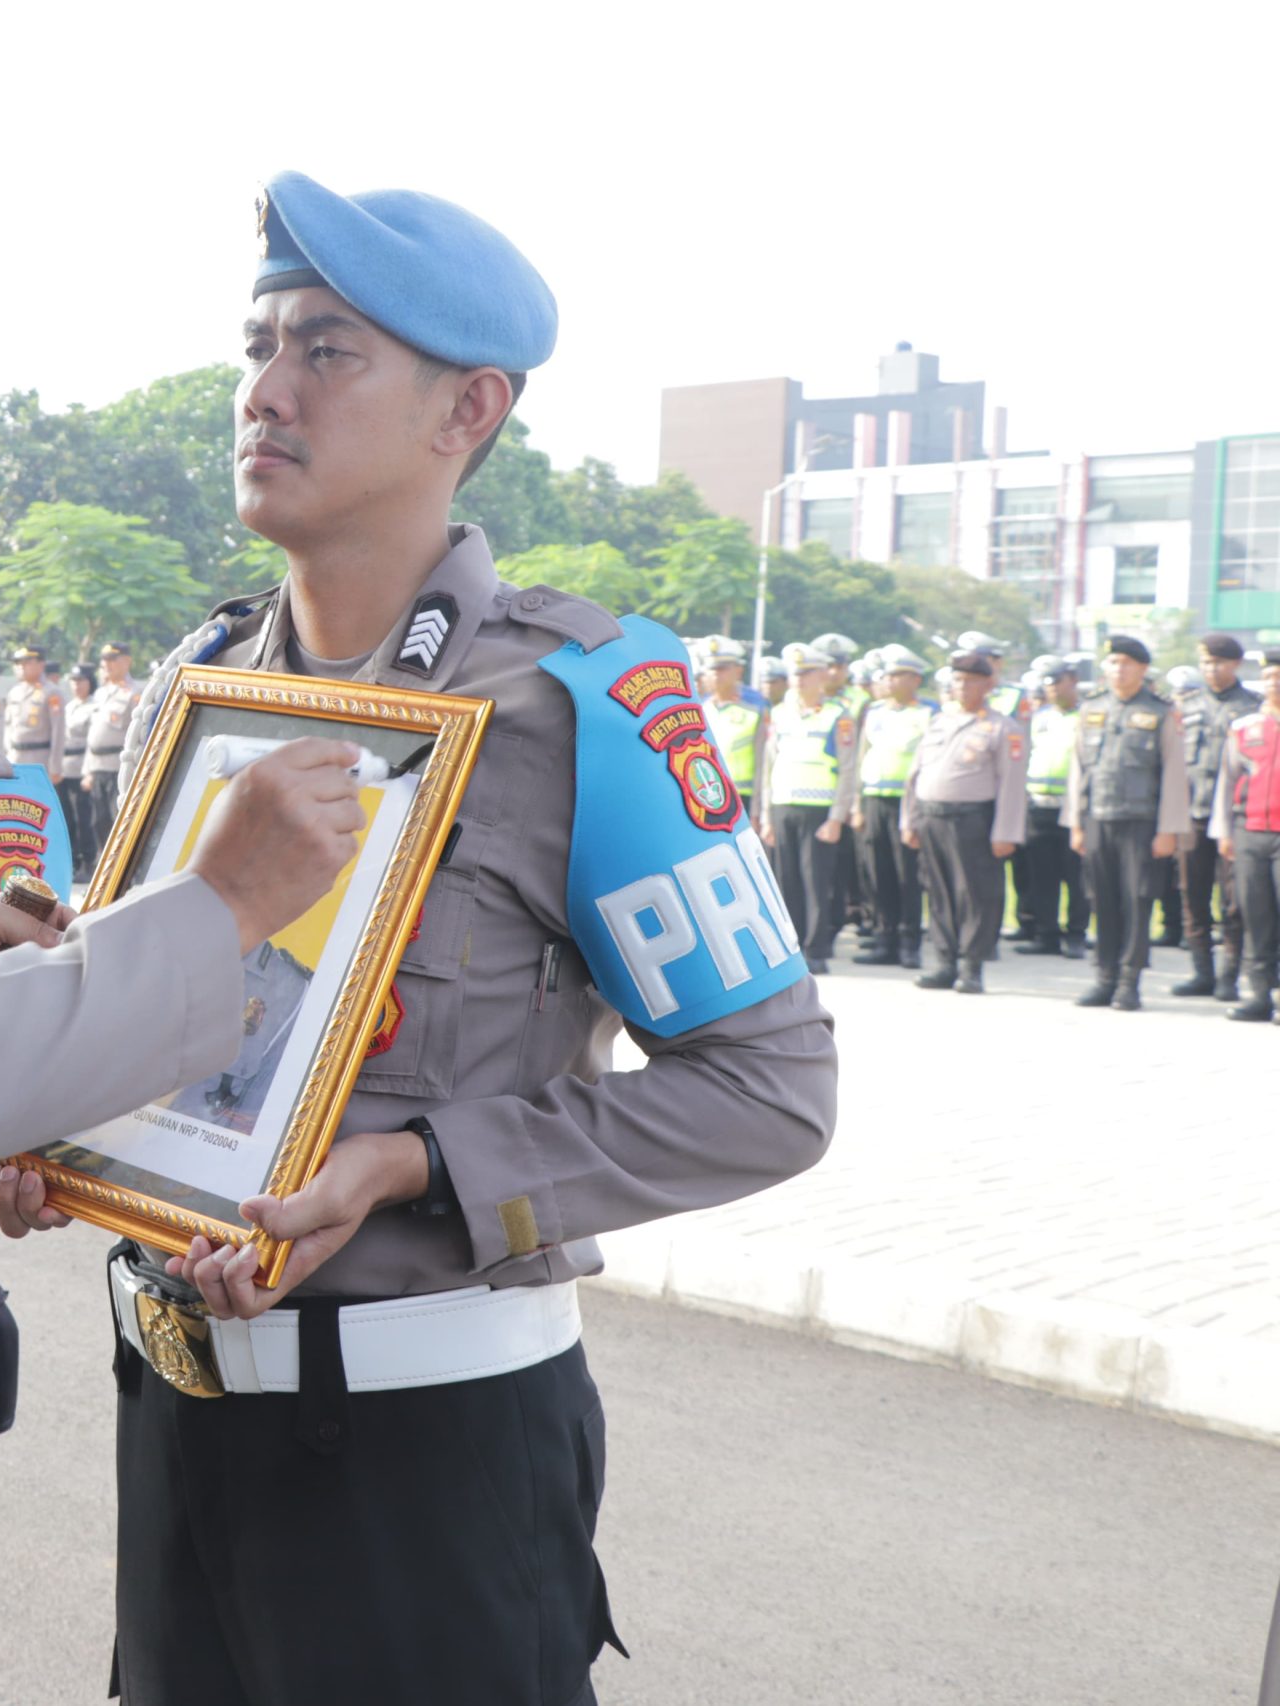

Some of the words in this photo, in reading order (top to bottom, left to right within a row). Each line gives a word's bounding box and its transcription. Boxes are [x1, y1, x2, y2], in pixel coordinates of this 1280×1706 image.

[618, 671, 650, 701] POLRES
[646, 666, 682, 681] METRO
[648, 715, 679, 744] METRO
[677, 709, 701, 726] JAYA
[11, 799, 42, 817] METRO
[19, 833, 43, 848] JAYA
[133, 1109, 179, 1132] GUNAWAN
[179, 1122, 199, 1138] NRP
[199, 1129, 239, 1152] 79020043
